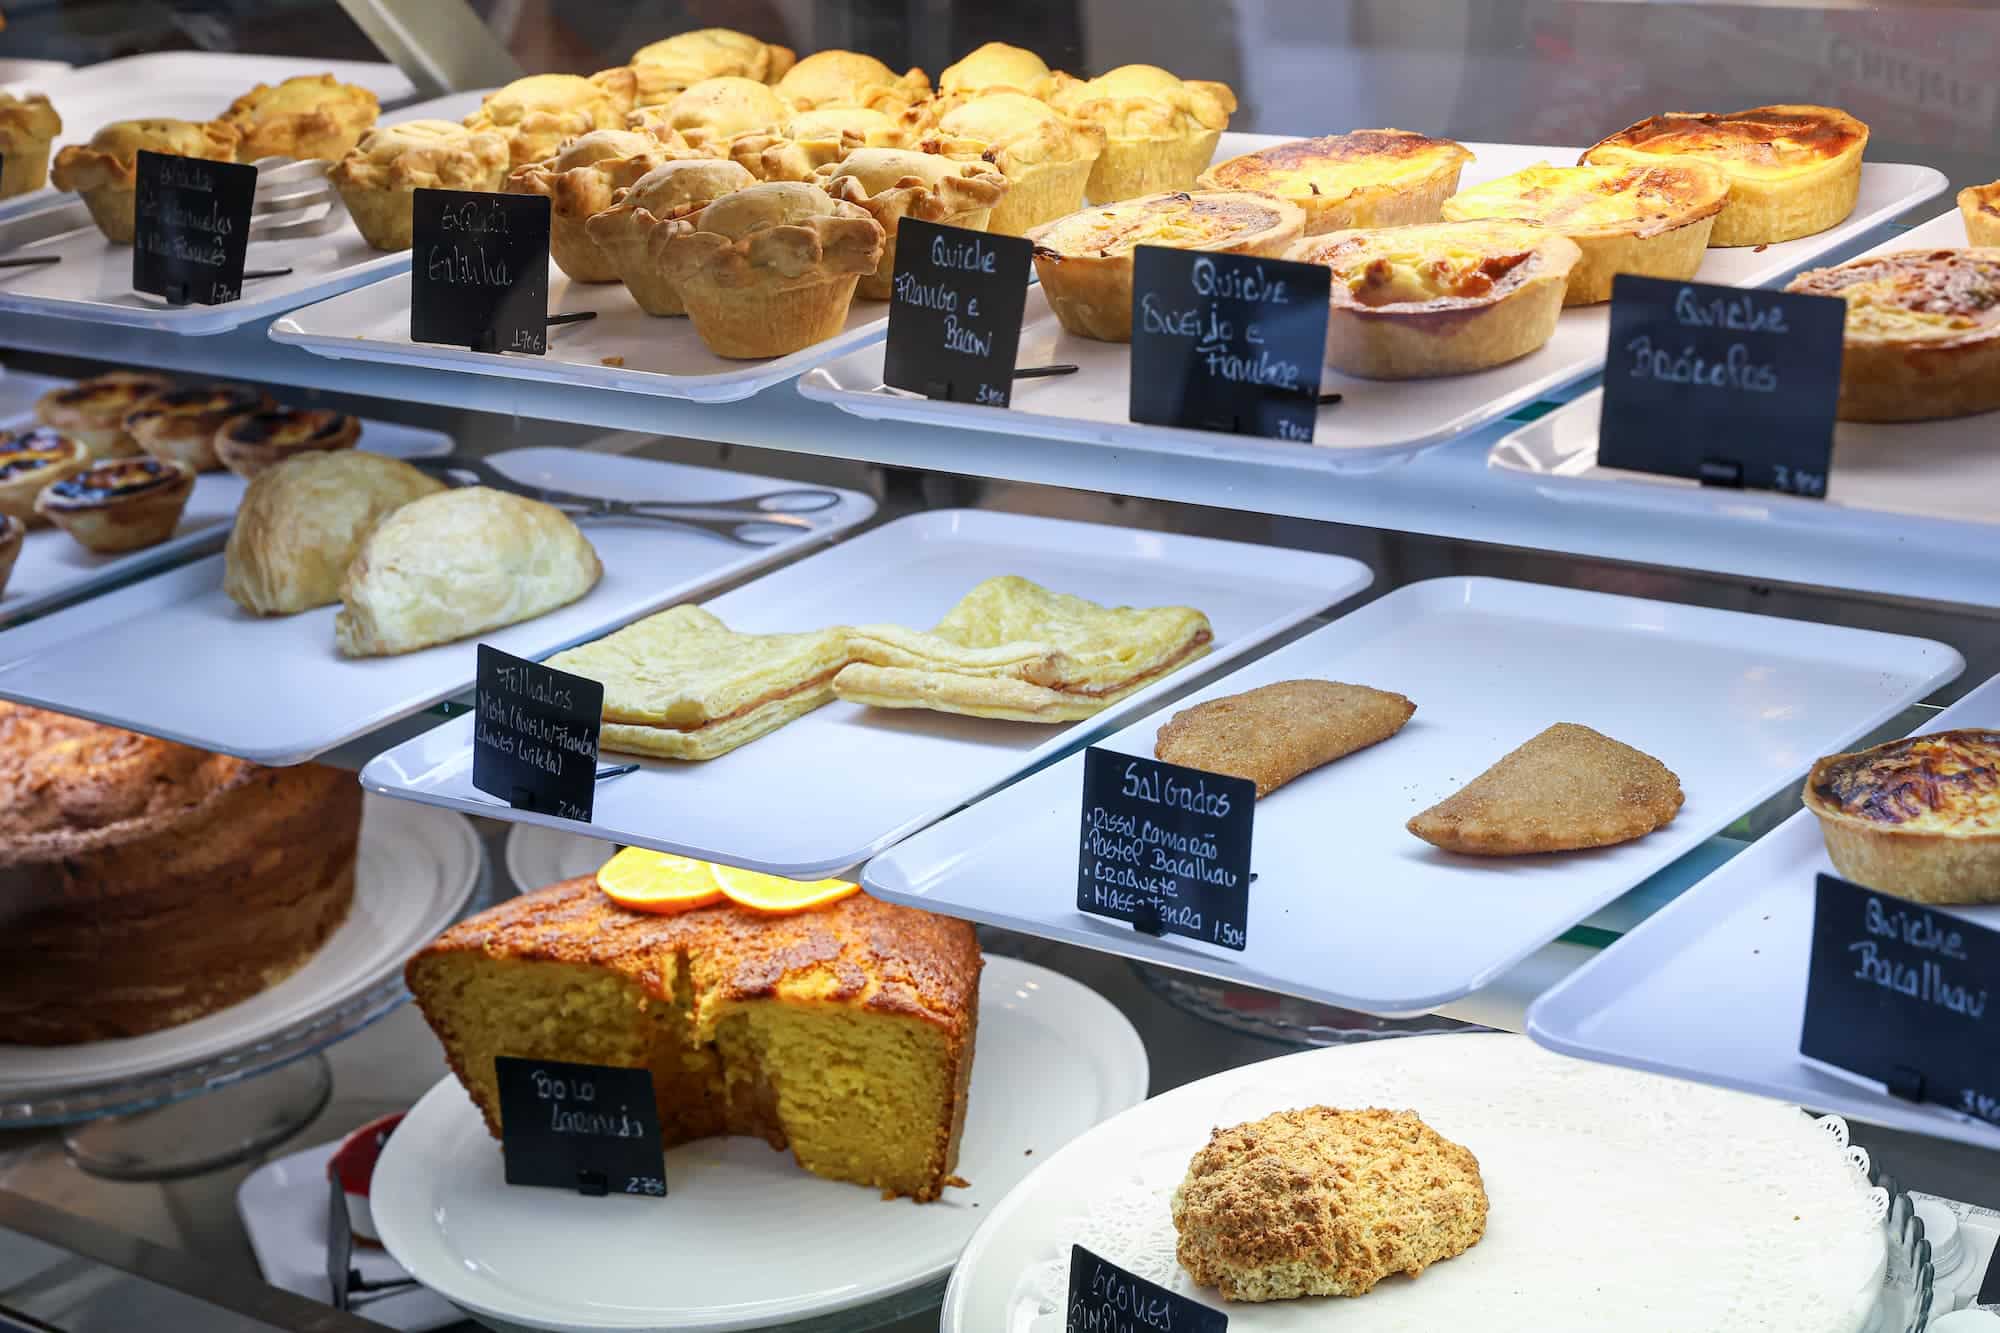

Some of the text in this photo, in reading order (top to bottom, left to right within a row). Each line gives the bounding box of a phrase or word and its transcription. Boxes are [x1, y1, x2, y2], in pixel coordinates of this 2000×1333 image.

[931, 233, 997, 273] Quiche
[1192, 256, 1289, 304] Quiche
[1674, 285, 1790, 334] Quiche
[1149, 847, 1238, 888] Bacalhau
[1864, 896, 1968, 961] Quiche
